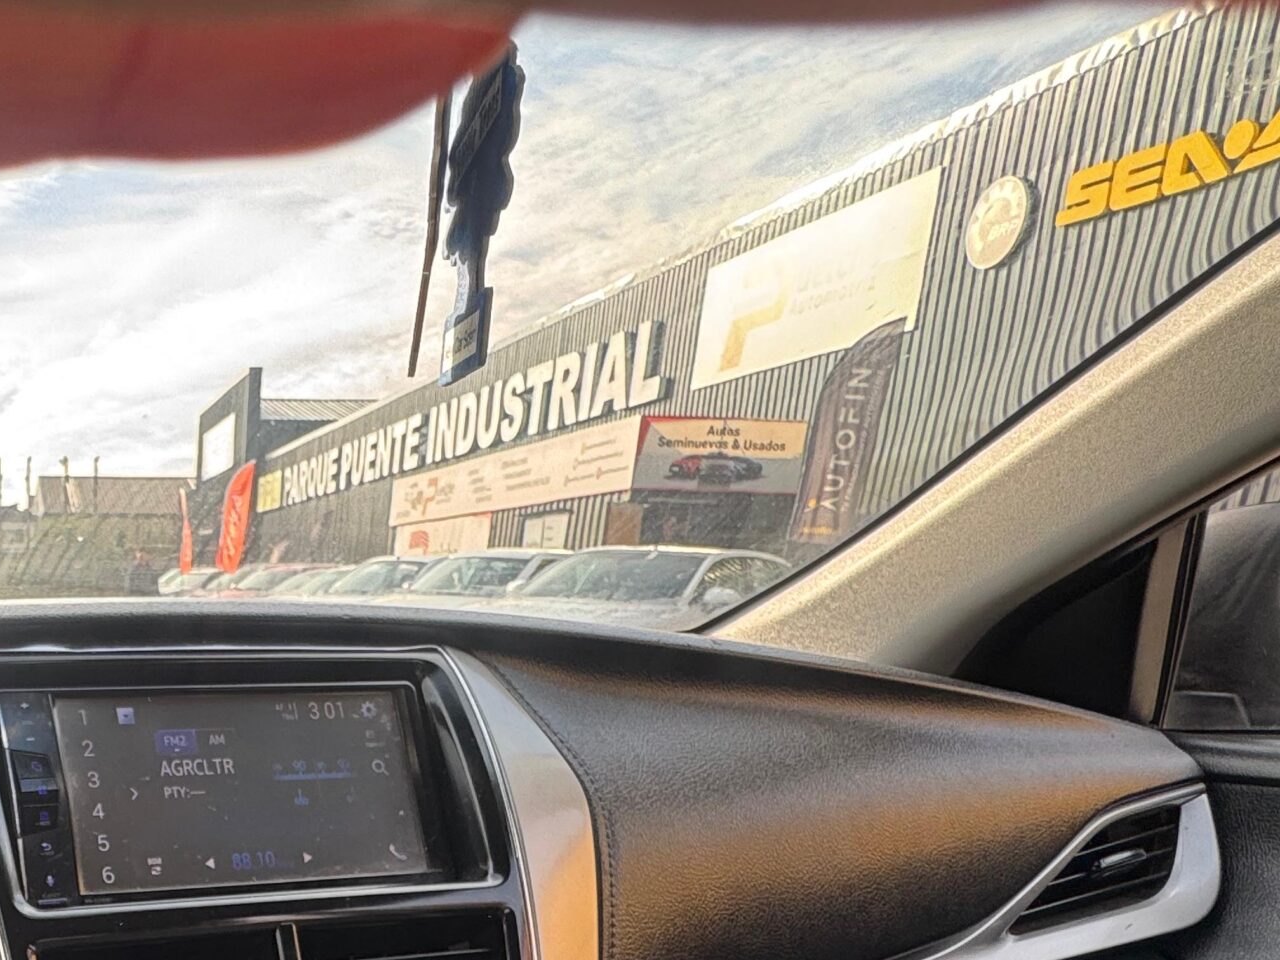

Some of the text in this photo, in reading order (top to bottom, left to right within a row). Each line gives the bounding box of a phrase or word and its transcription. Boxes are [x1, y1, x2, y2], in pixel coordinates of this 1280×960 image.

[283, 447, 339, 507] PARQUE
[339, 412, 422, 491] PUENTE
[425, 320, 661, 465] INDUSTRIAL
[706, 425, 741, 437] Autos
[819, 366, 872, 512] AUTOFIN
[657, 435, 729, 449] Seminuevos
[743, 438, 786, 451] Usados
[78, 709, 88, 725] 1
[308, 702, 344, 720] 301
[82, 740, 95, 757] 2
[164, 734, 225, 747] FM2 AM
[160, 758, 235, 777] AGRCLTR
[87, 771, 100, 788] 3
[92, 803, 105, 819] 4
[97, 834, 110, 852] 5
[232, 851, 276, 869] 8810
[101, 866, 116, 884] 6
